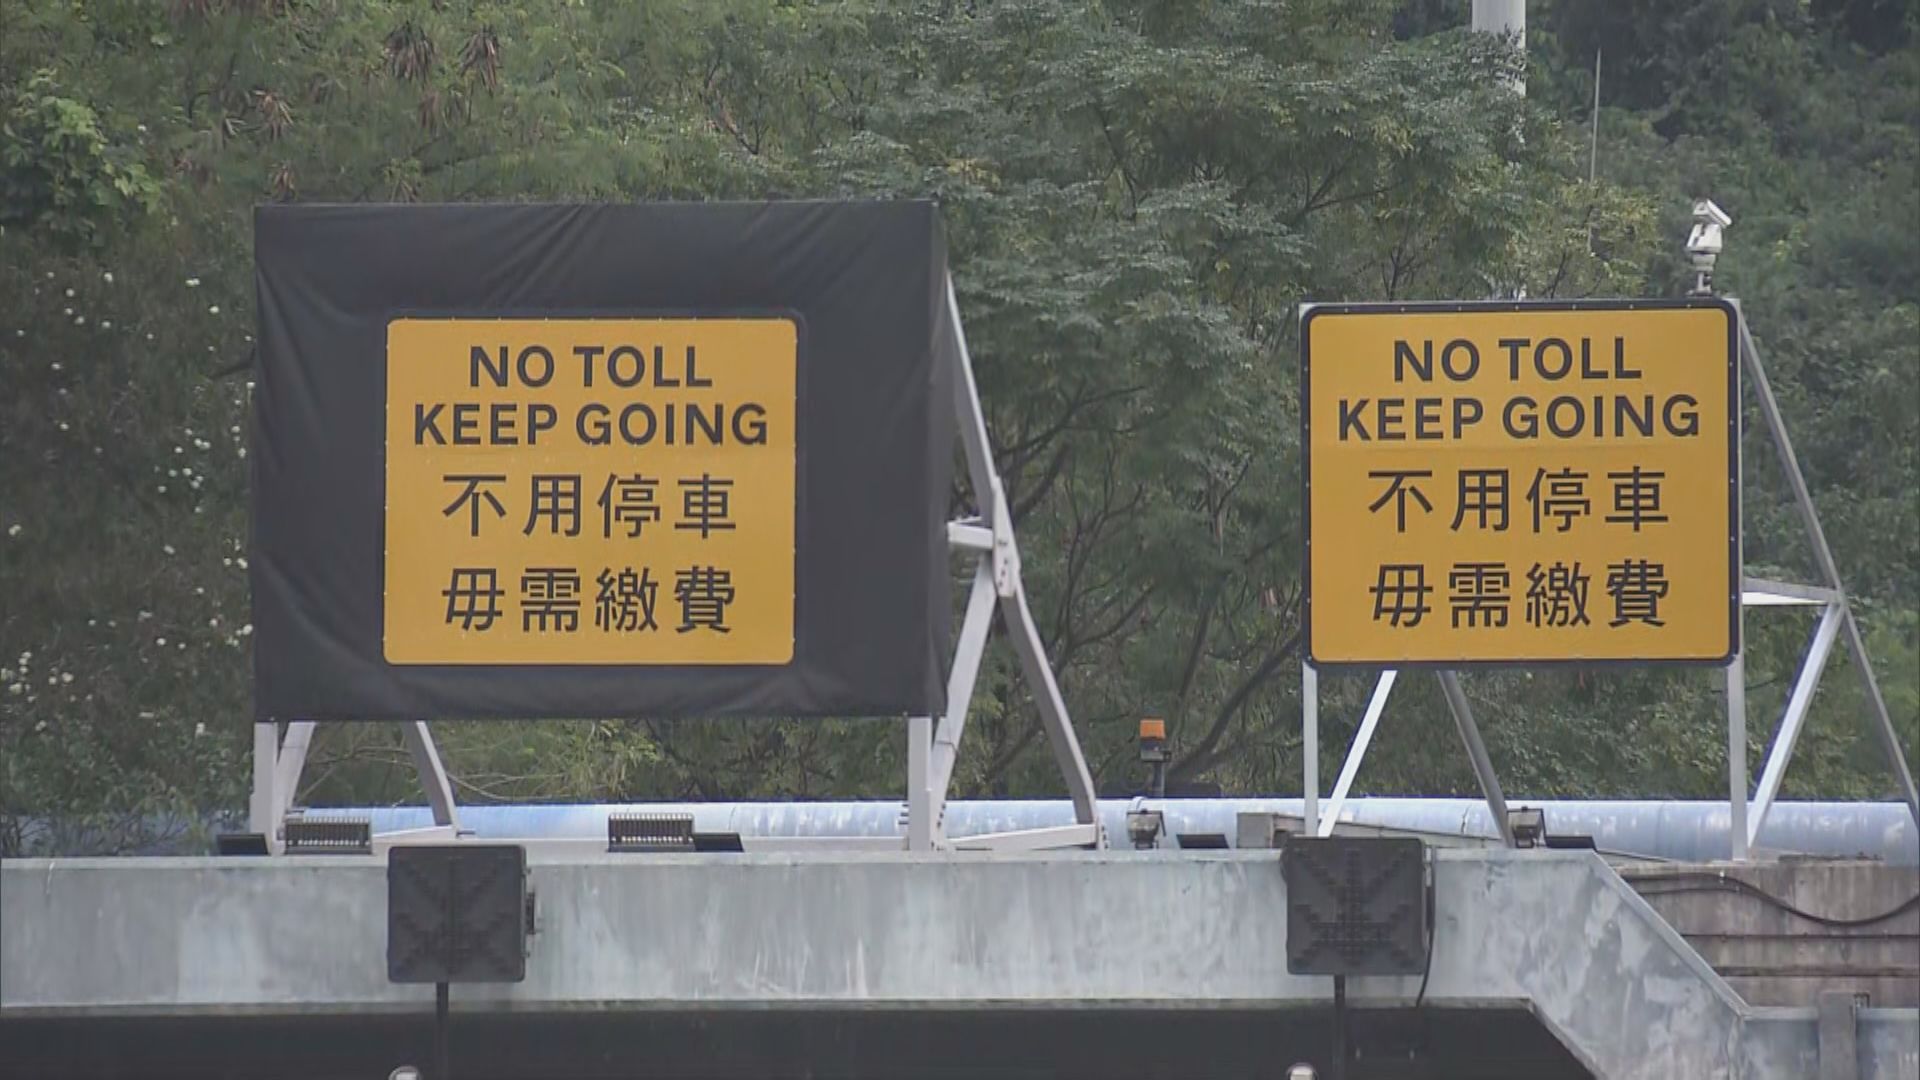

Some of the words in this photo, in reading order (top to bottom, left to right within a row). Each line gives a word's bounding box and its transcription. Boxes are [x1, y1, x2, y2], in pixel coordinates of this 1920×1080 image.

[470, 345, 555, 388] NO
[573, 345, 713, 388] TOLL
[1393, 338, 1480, 382] NO
[1498, 336, 1642, 381] TOLL
[414, 403, 558, 445] KEEP
[575, 402, 767, 446] GOING
[1338, 397, 1484, 441] KEEP
[1502, 393, 1700, 439] GOING
[442, 473, 737, 540] 不用停車
[1367, 465, 1670, 534] 不用停車
[441, 565, 737, 634] 毋需繳費
[1368, 558, 1670, 629] 毋需繳費
